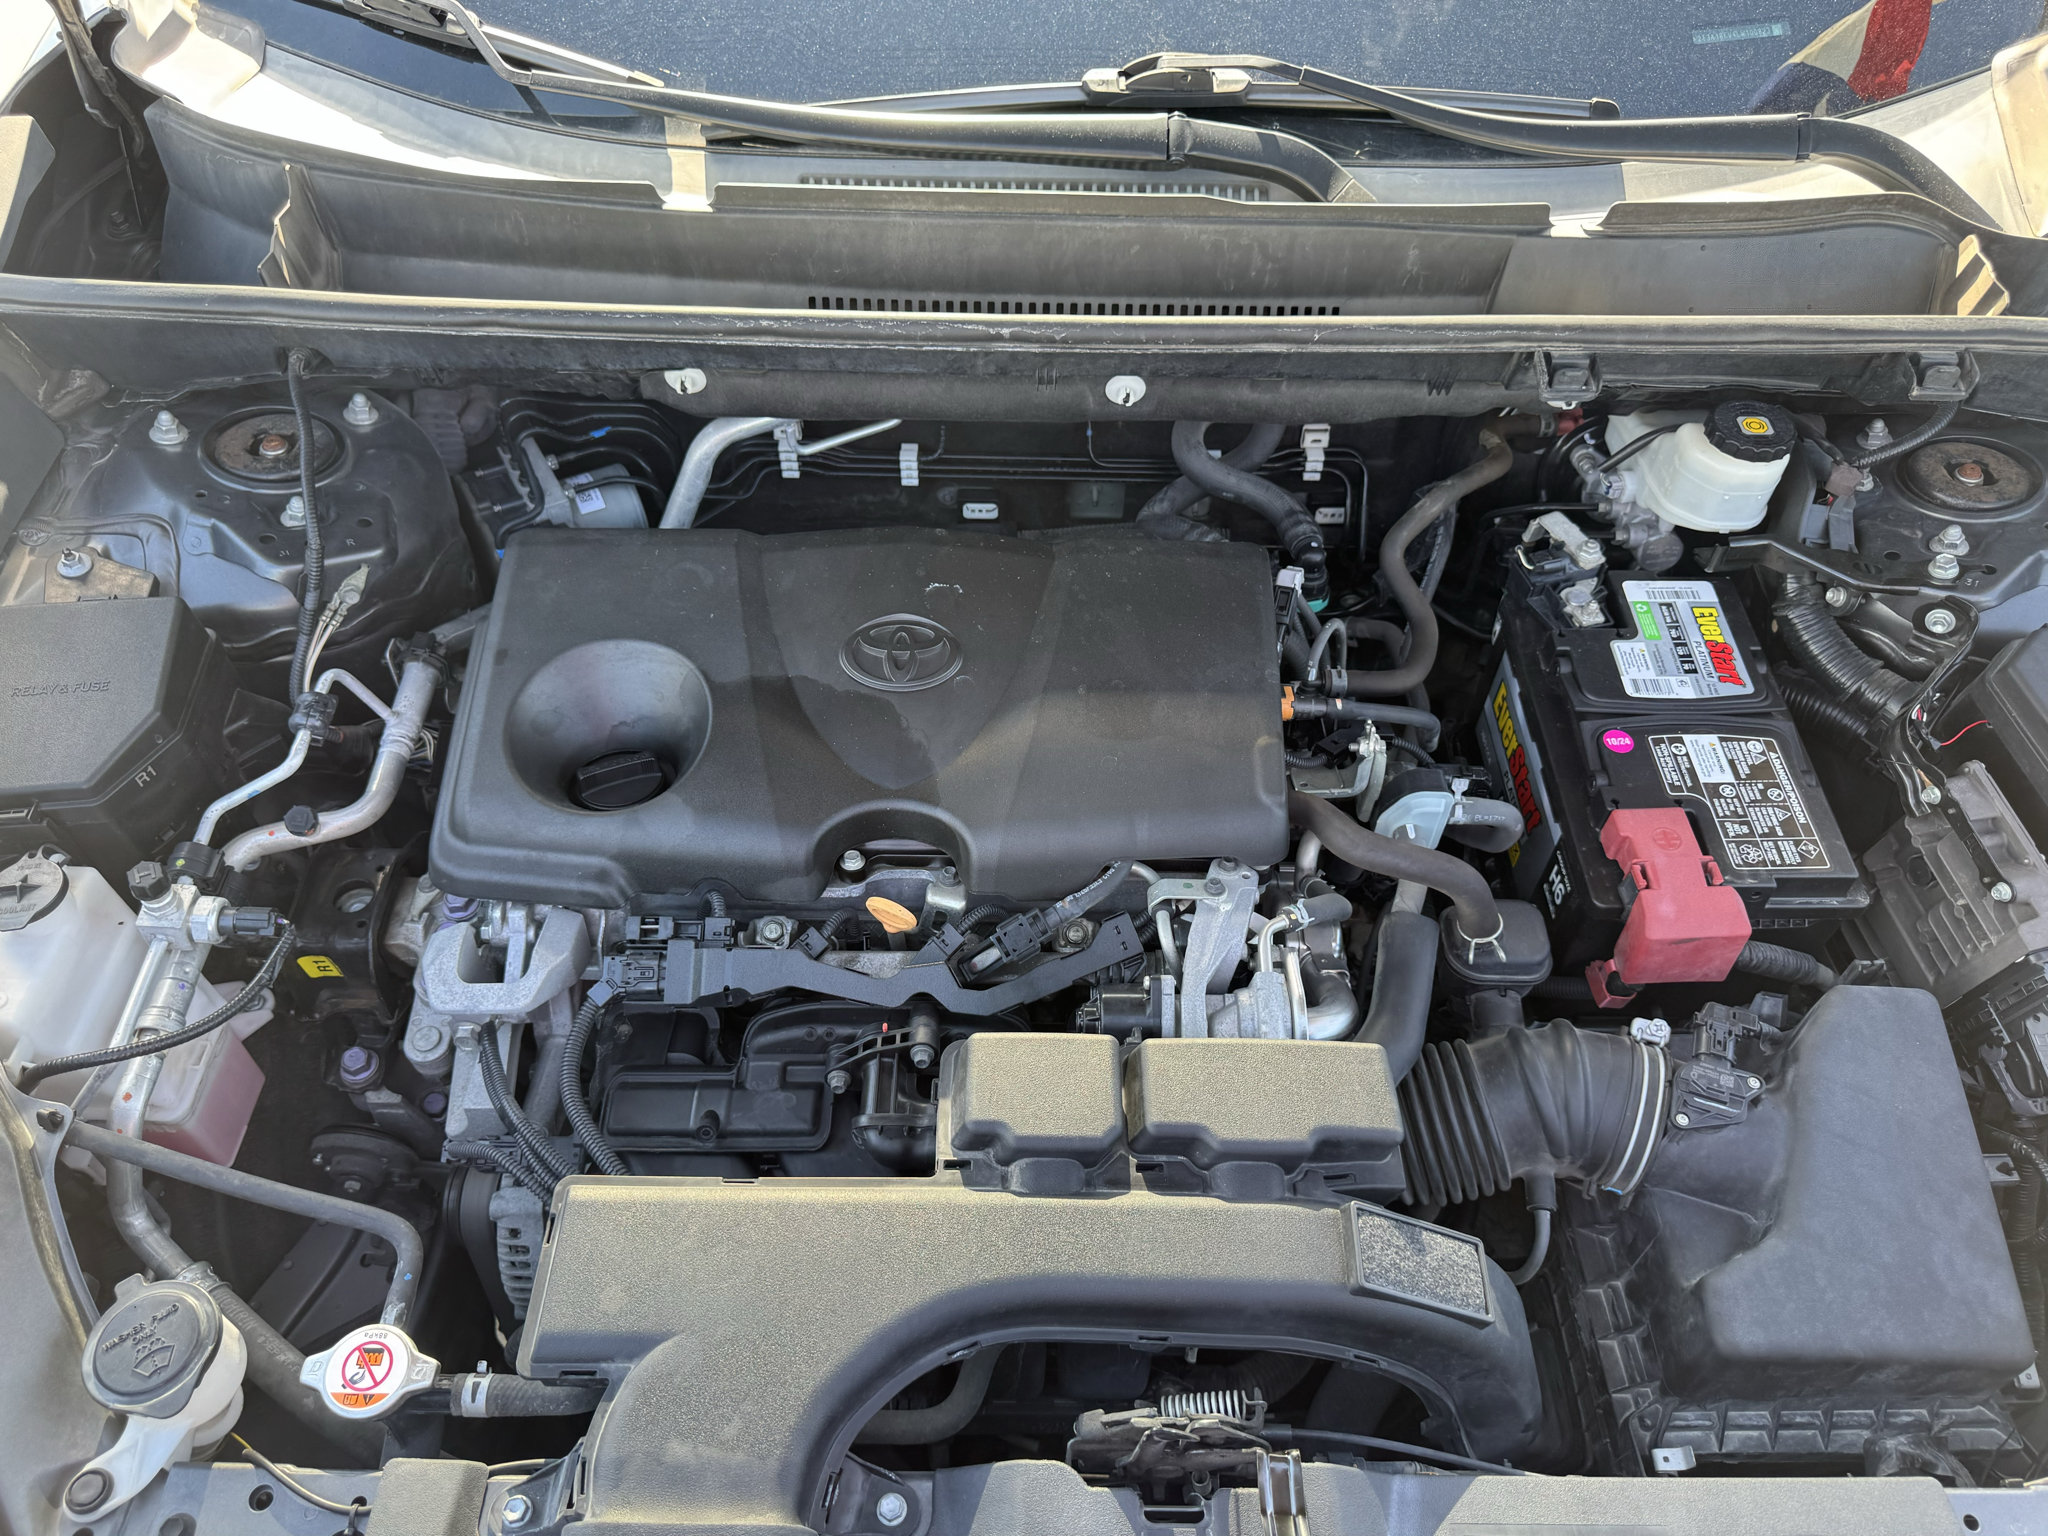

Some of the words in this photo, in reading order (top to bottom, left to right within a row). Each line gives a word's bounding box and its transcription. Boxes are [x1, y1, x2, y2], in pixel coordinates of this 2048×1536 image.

[1691, 607, 1747, 686] EverStart
[1692, 640, 1714, 678] PLATINUM
[11, 684, 57, 697] RELAY
[60, 684, 69, 694] &
[73, 681, 110, 693] FUSE
[1606, 737, 1632, 746] 10/24
[1494, 681, 1541, 834] EverStart
[1658, 743, 1681, 785] NON-SPILLABLE
[135, 765, 157, 787] R1
[1772, 759, 1807, 823] DANGER/POISON
[1549, 865, 1565, 905] H6
[312, 960, 333, 972] R1
[132, 1325, 157, 1345] ONLY
[364, 1331, 388, 1340] 88kPa
